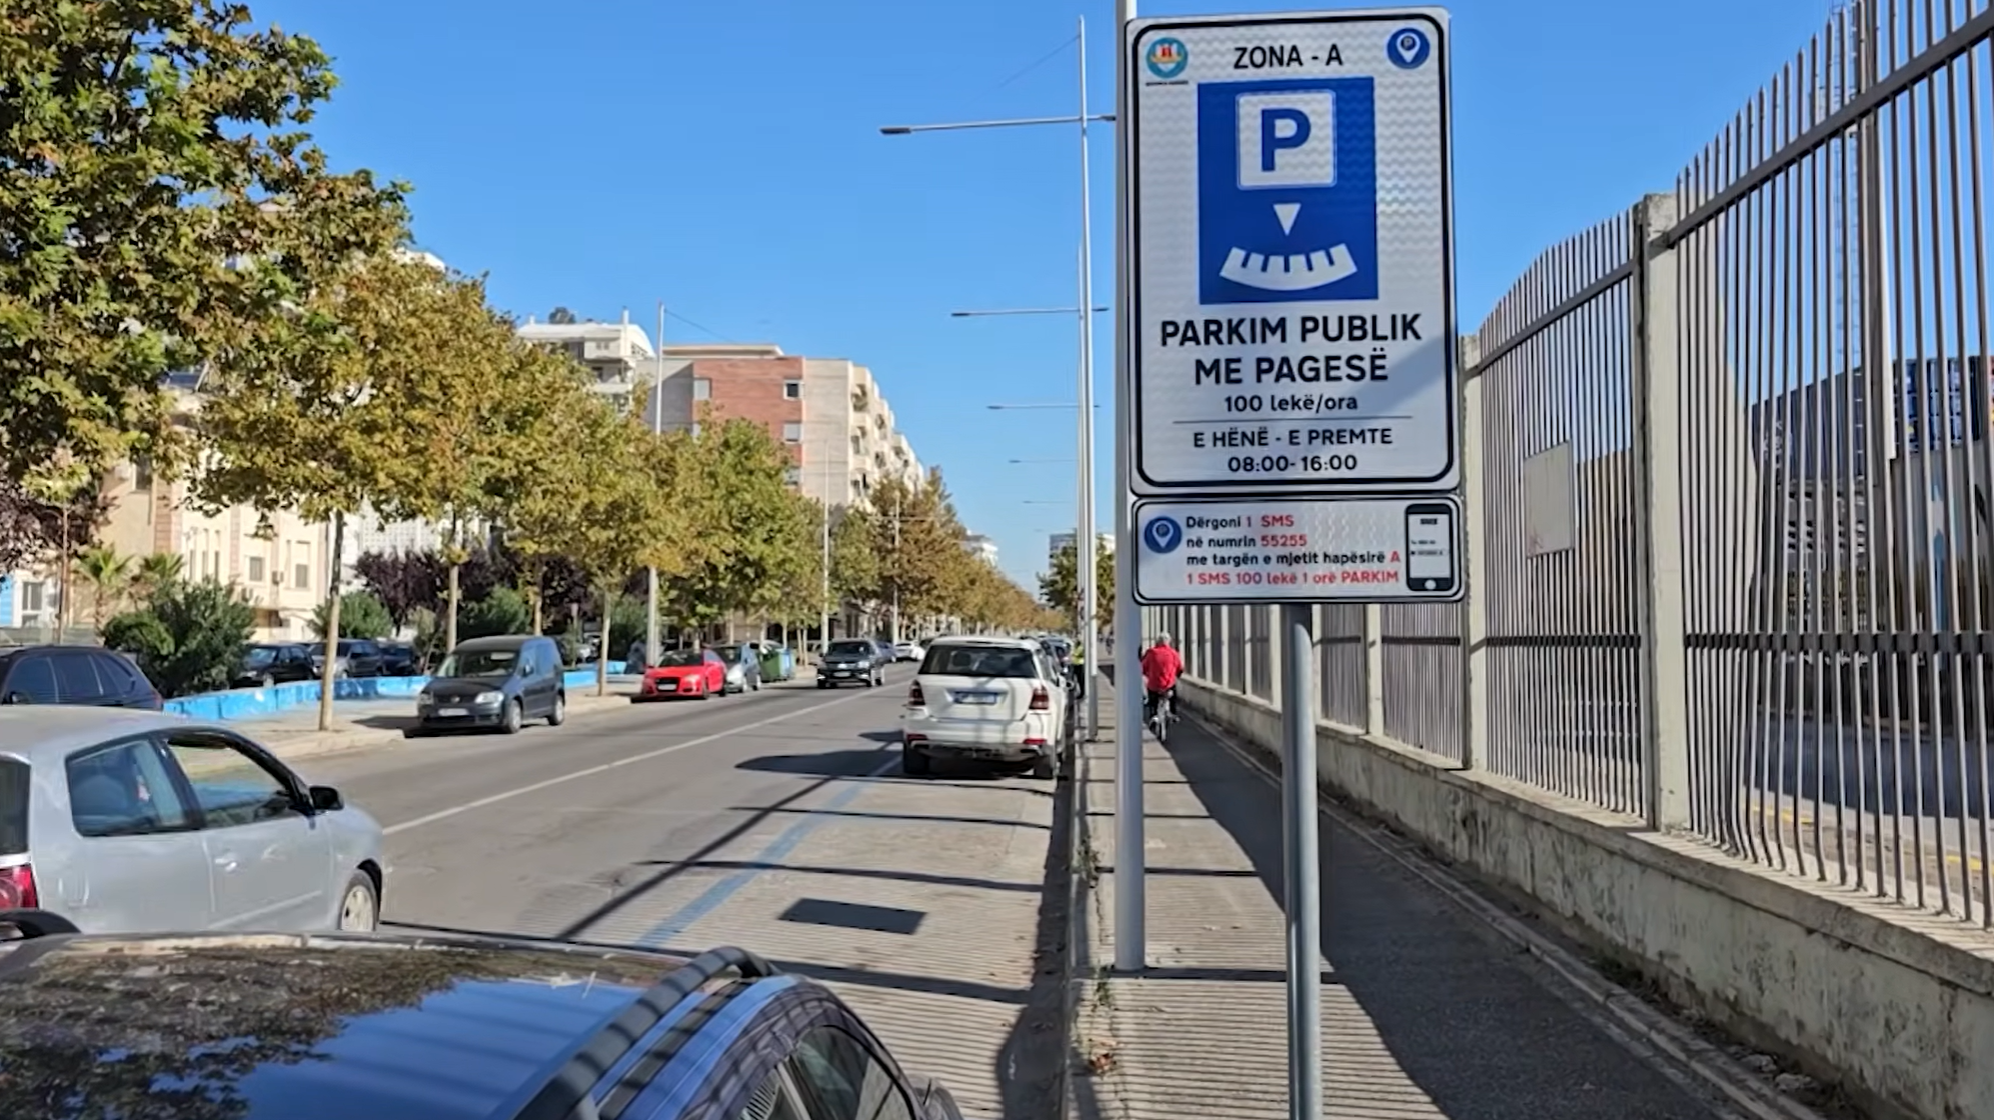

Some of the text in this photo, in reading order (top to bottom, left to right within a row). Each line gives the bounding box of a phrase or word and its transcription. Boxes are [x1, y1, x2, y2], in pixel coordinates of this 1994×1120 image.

[1233, 45, 1303, 69] ZONA
[1325, 43, 1343, 66] A
[1261, 108, 1311, 172] P
[1161, 313, 1422, 347] PARKIM PUBLIK
[1195, 347, 1388, 385] ME PAGESË
[1225, 394, 1358, 413] 100 lekë/ora
[1194, 432, 1205, 447] E
[1213, 427, 1269, 447] HËNË
[1289, 430, 1300, 445] E
[1308, 428, 1393, 445] PREMTE
[1186, 515, 1294, 530] Dërgoni 1 SMS
[1186, 534, 1307, 548] në numrin 55255
[1186, 554, 1207, 565] me
[1213, 553, 1258, 567] targën
[1263, 554, 1271, 564] e
[1276, 552, 1318, 566] mjetit
[1323, 551, 1385, 565] hapësirë
[1390, 551, 1400, 562] A
[1187, 573, 1193, 584] 1
[1198, 573, 1230, 584] SMS
[1236, 572, 1262, 584] 100
[1303, 572, 1308, 583] 1
[1341, 571, 1398, 583] PARKIM
